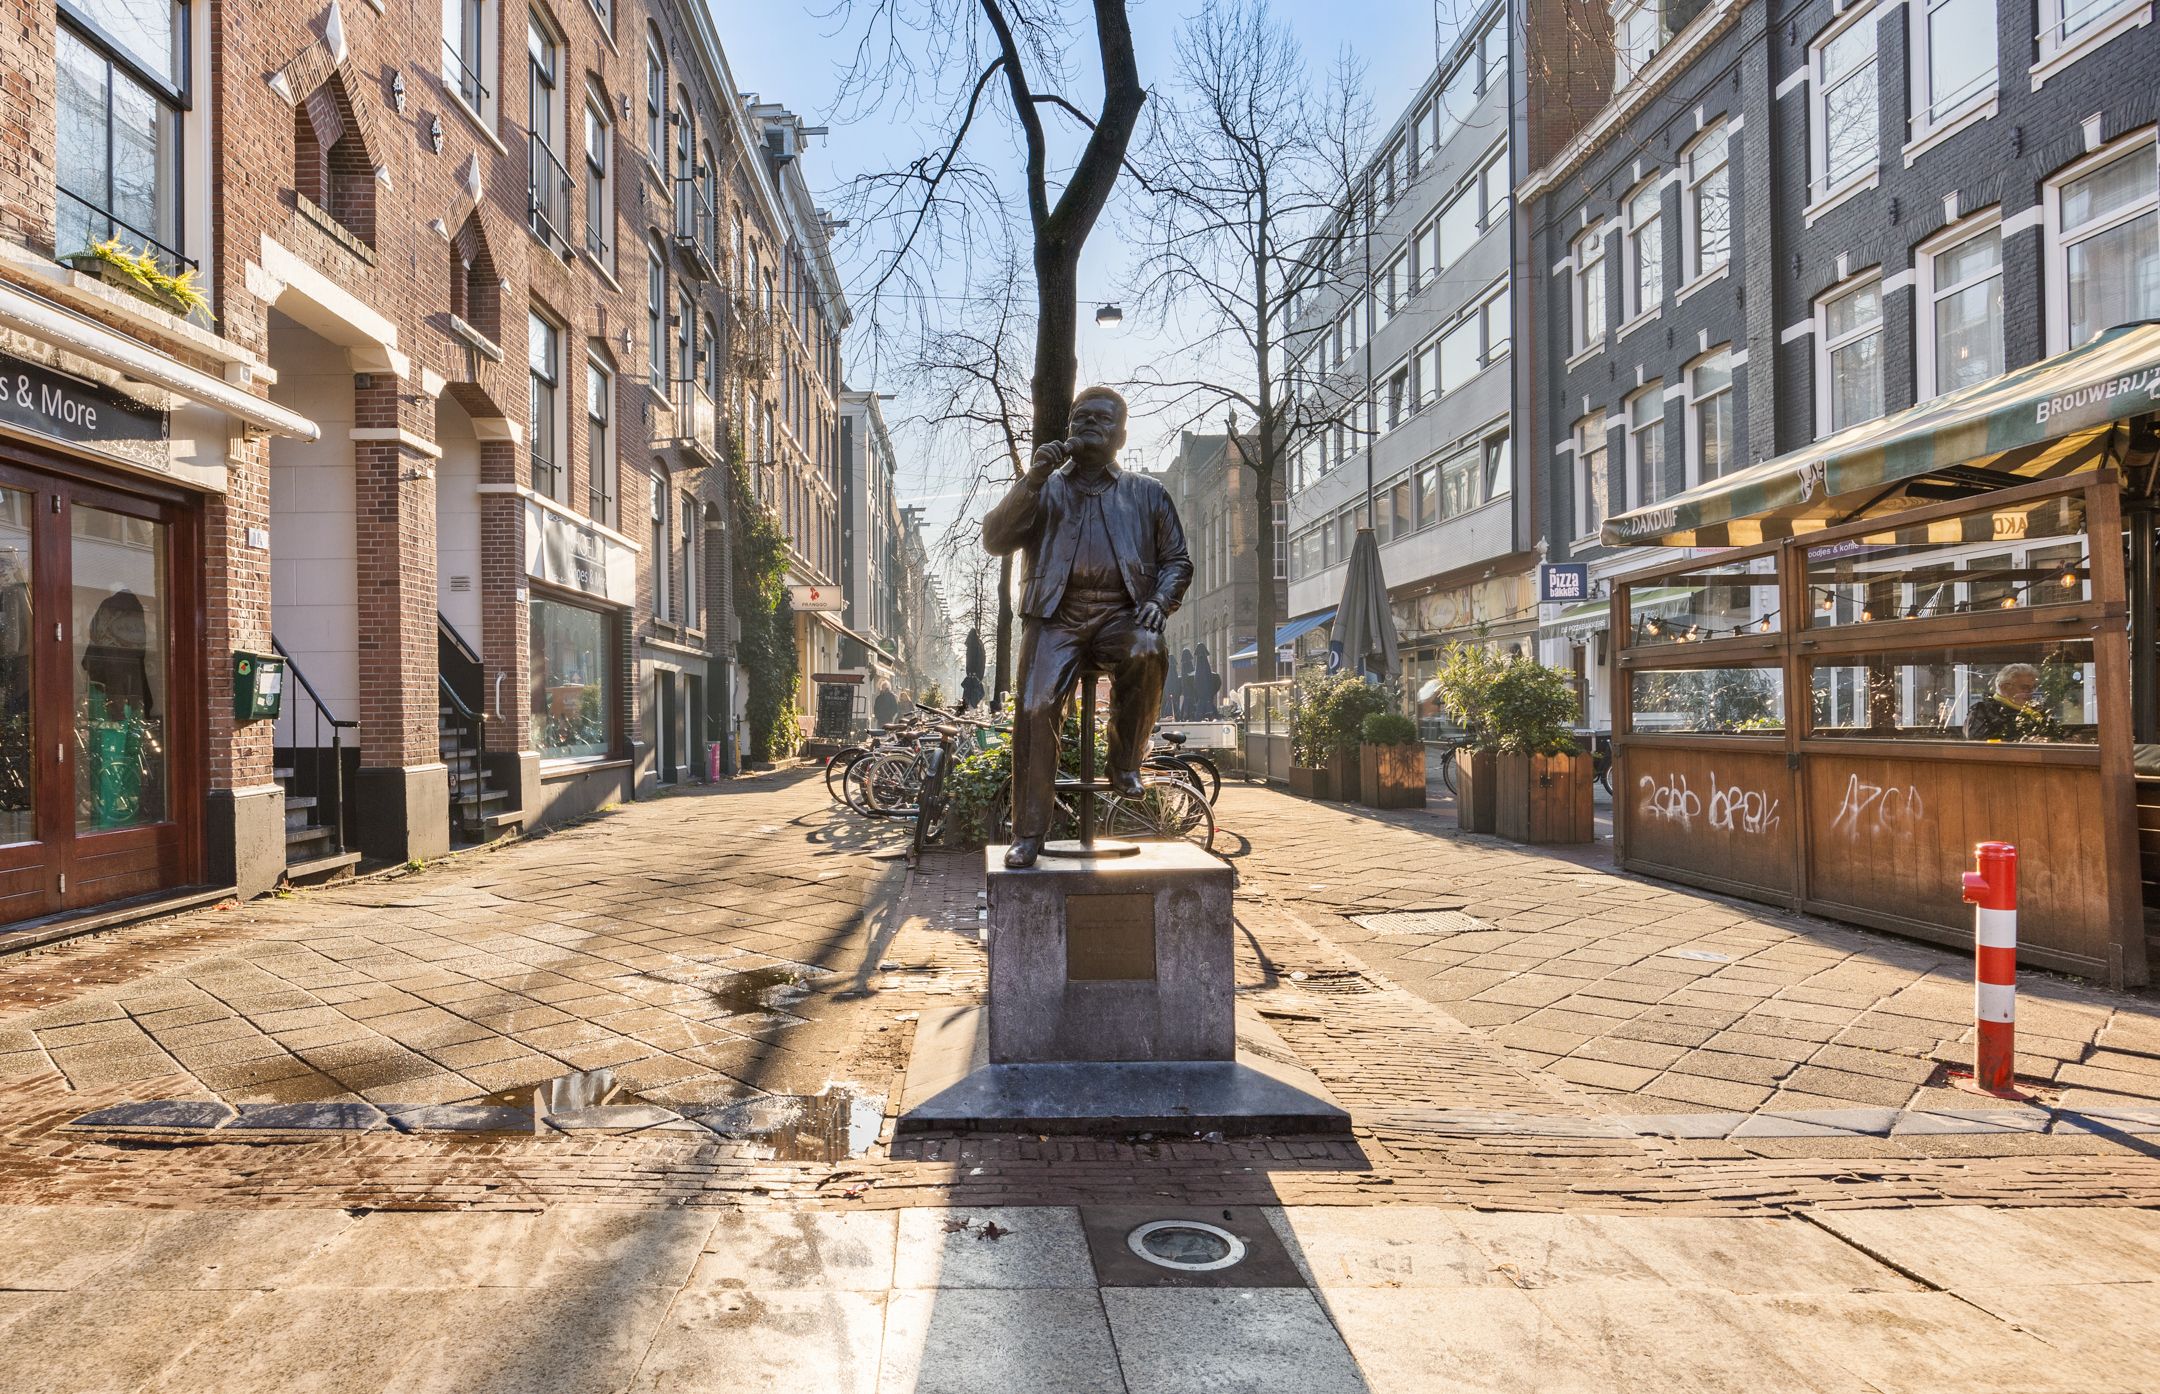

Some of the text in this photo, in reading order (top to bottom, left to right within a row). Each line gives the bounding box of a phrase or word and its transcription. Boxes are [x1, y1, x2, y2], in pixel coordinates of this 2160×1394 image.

[16, 374, 35, 411] &
[41, 383, 97, 430] More
[2036, 371, 2147, 424] BROUWERIJ
[1631, 506, 1679, 536] DAKDUIF
[1550, 587, 1580, 597] bakkers
